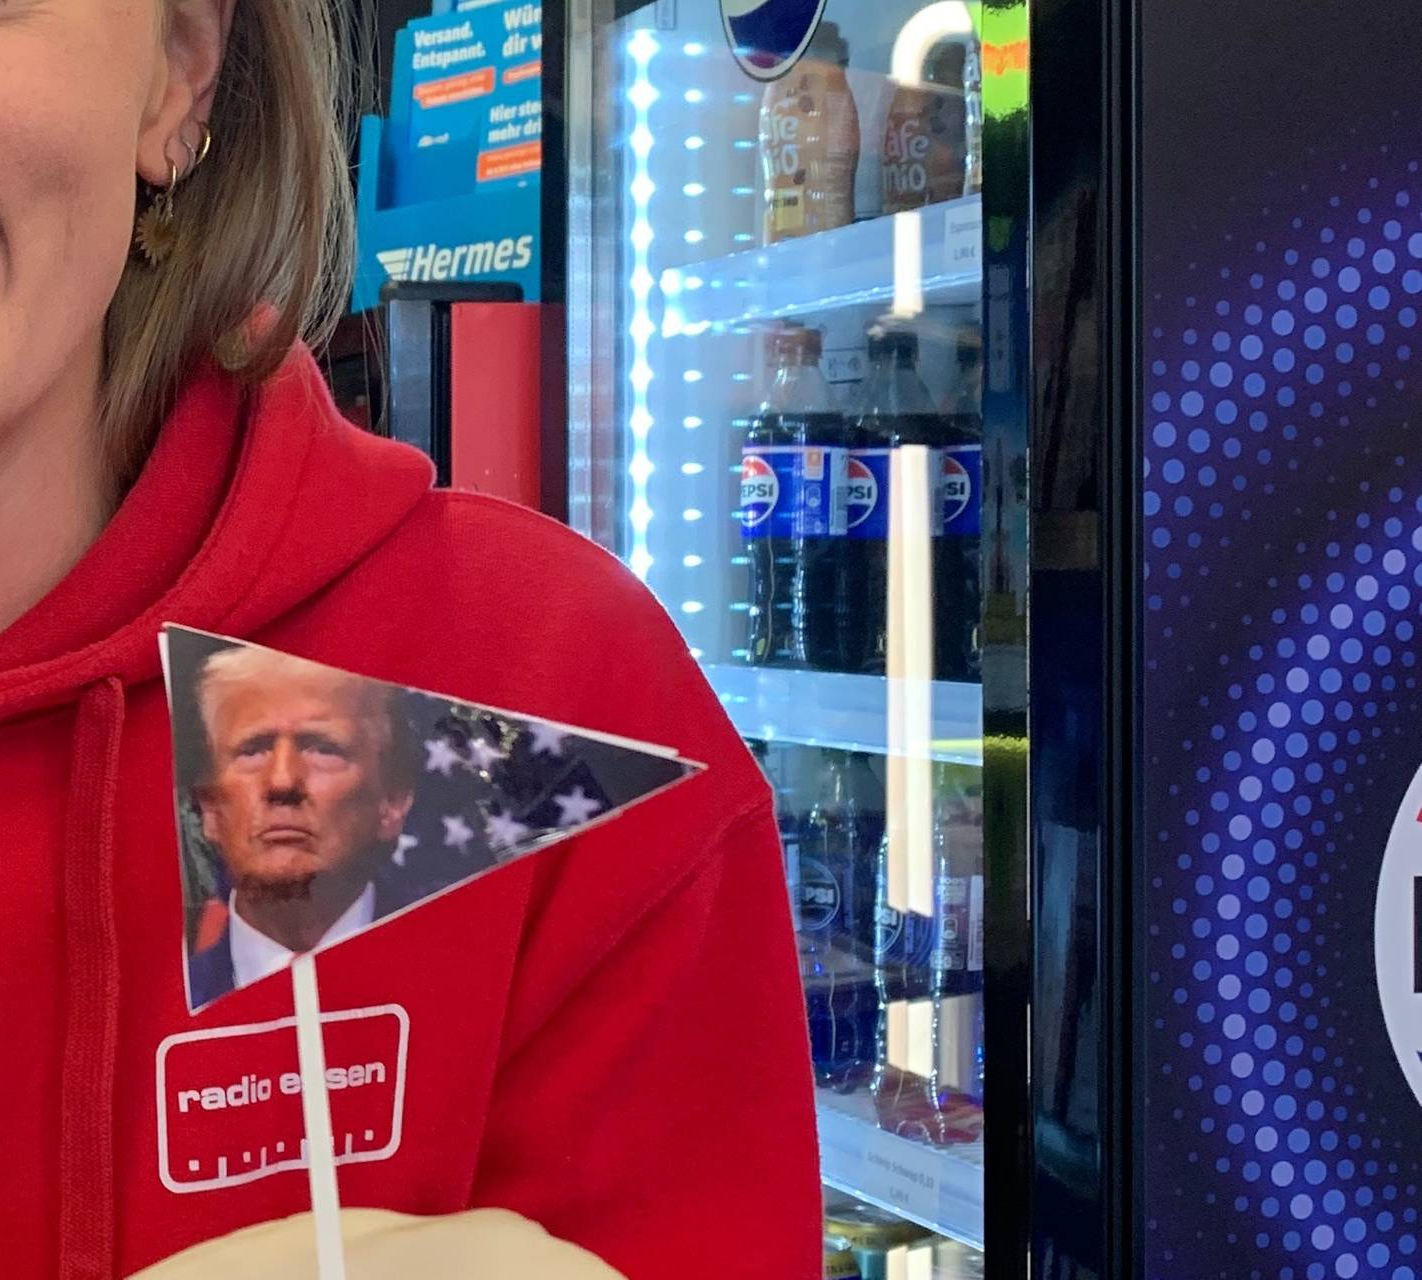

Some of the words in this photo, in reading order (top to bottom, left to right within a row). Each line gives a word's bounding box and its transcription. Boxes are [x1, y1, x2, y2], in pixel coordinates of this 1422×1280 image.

[414, 20, 474, 48] Versand.
[502, 31, 528, 58] dir
[413, 40, 486, 70] Entspannt.
[411, 235, 533, 282] Hermes
[178, 1074, 272, 1113] radio
[279, 1061, 386, 1095] esen
